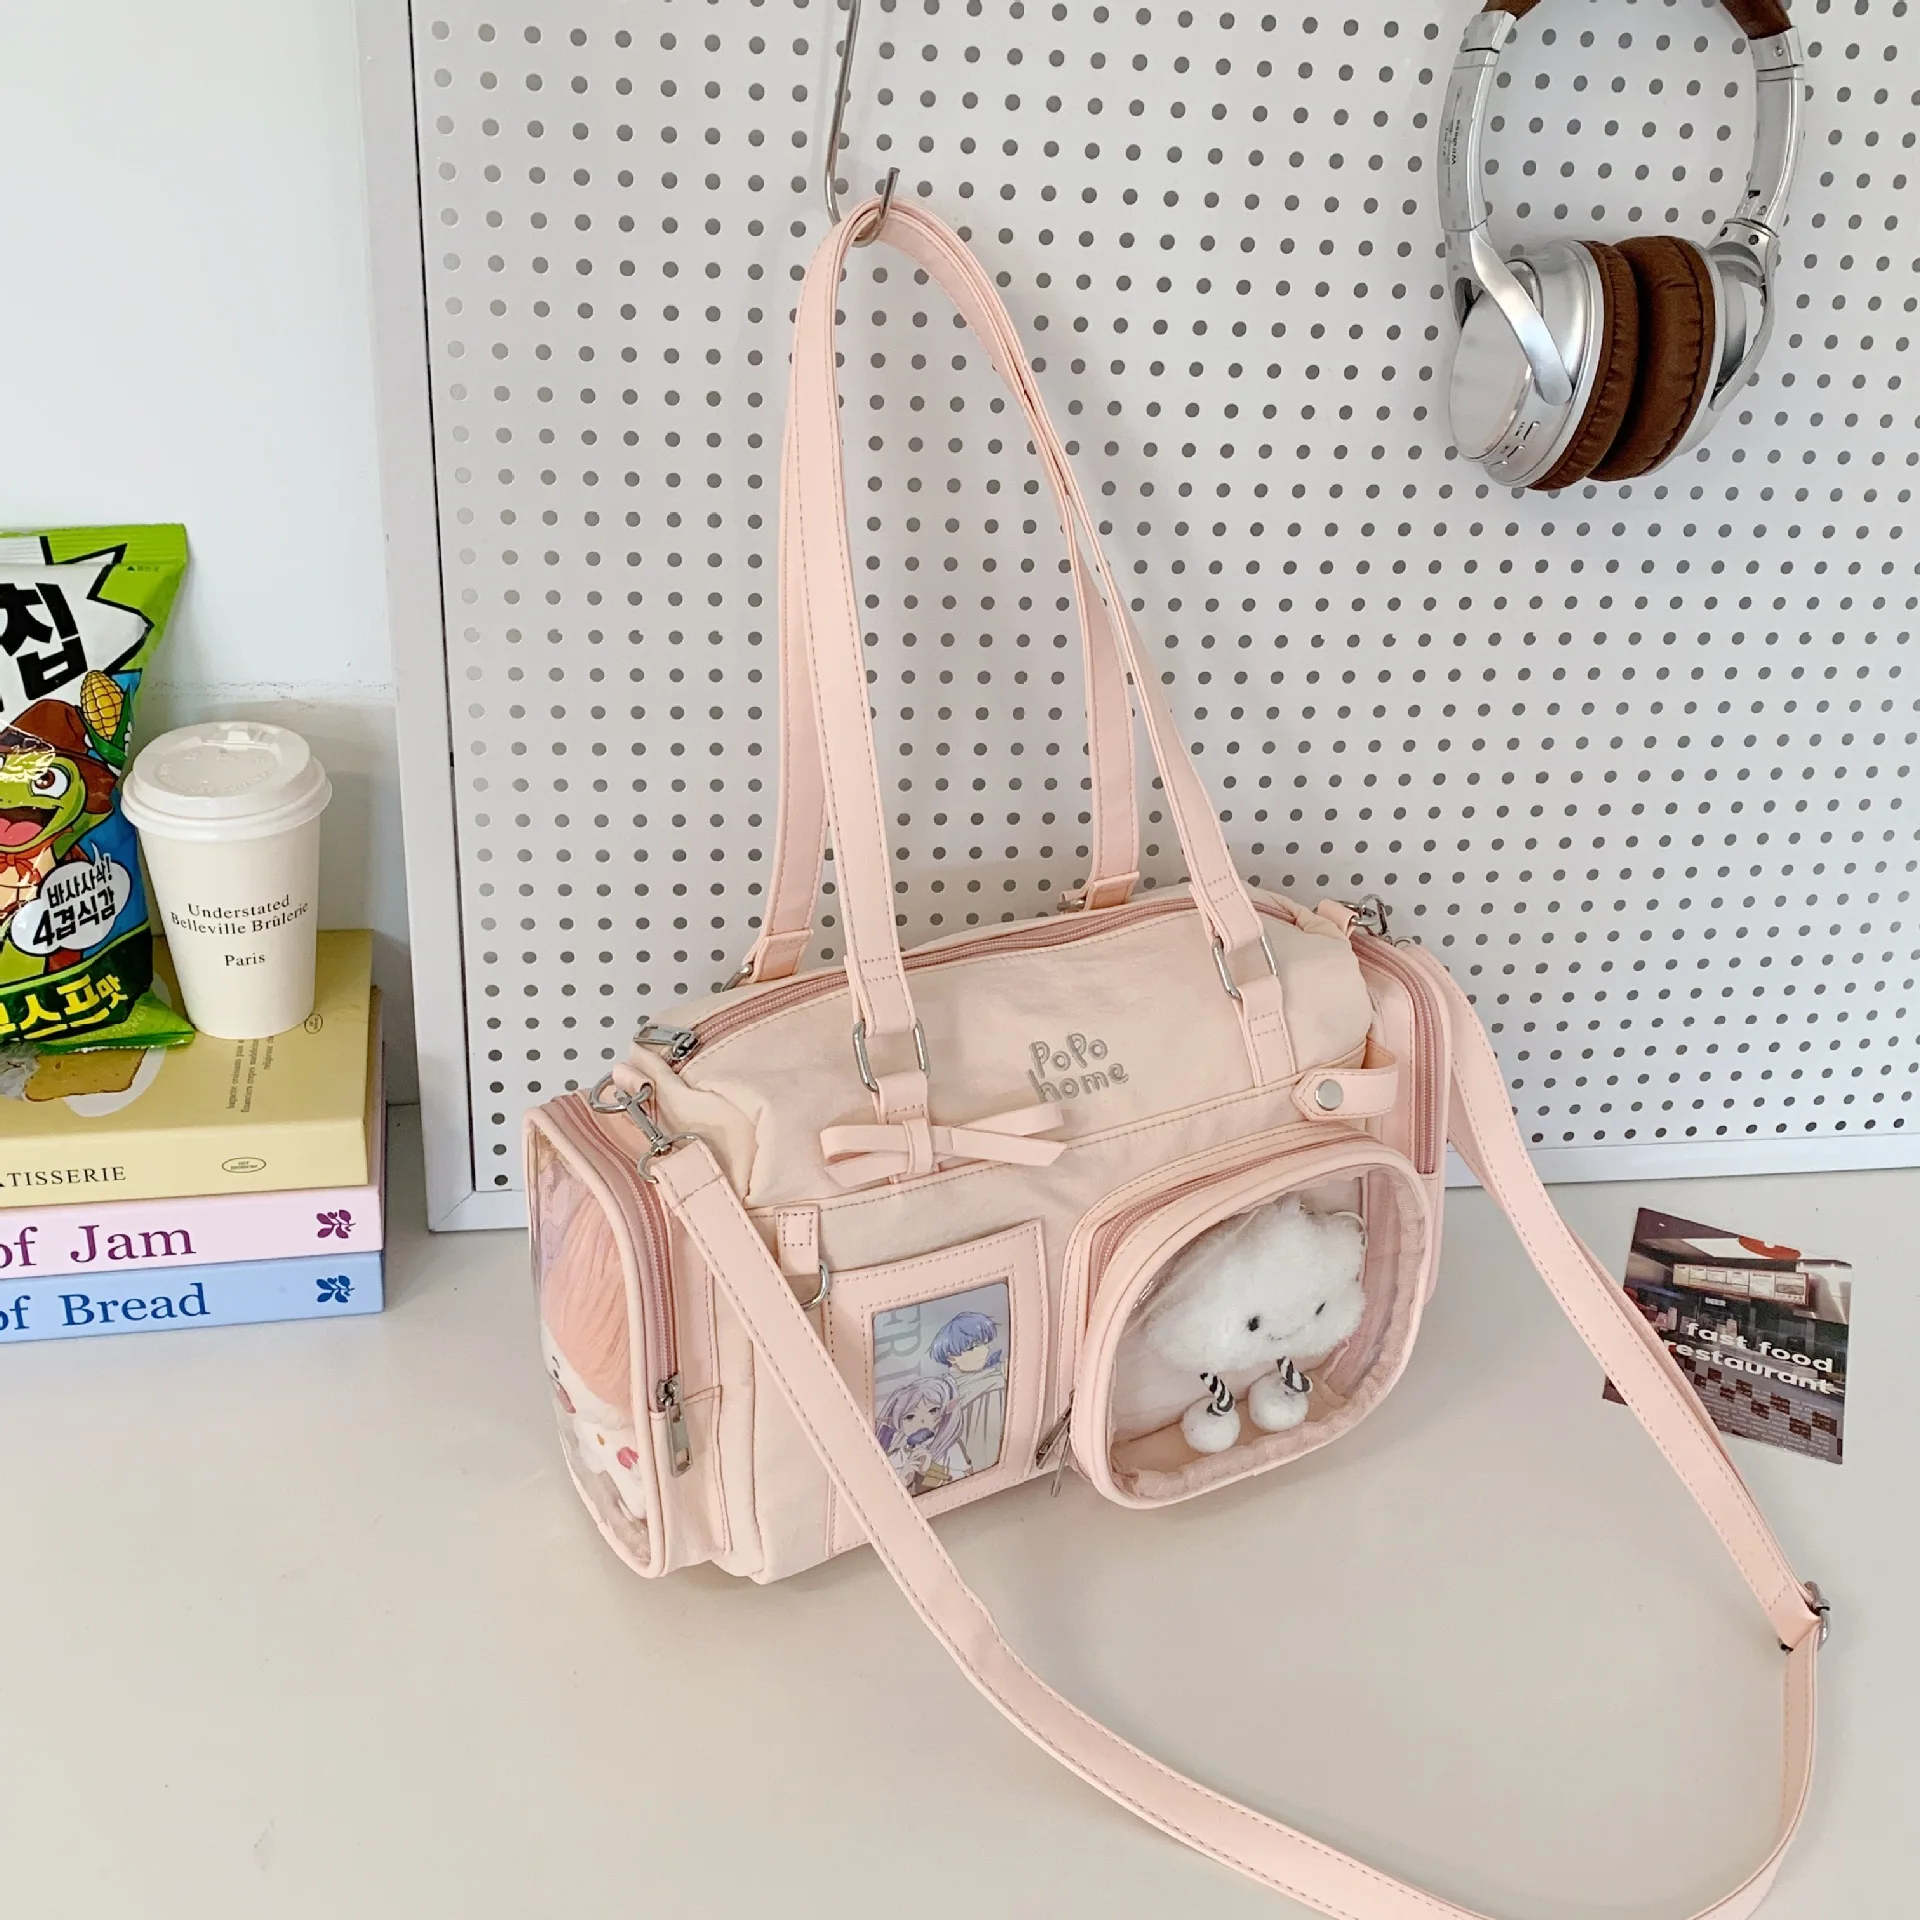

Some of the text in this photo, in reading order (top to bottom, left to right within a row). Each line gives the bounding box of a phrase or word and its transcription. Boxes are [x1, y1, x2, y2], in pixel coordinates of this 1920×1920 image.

[0, 582, 88, 700] 칩
[33, 886, 115, 946] 4겹식감
[170, 902, 309, 935] Belleville Brûlerie
[187, 894, 291, 919] Understated
[224, 952, 266, 967] Paris
[0, 974, 128, 1034] 스프맛
[1028, 1032, 1108, 1079] PoPo
[1026, 1068, 1129, 1104] home
[0, 1166, 126, 1188] TISSERIE
[70, 1224, 197, 1264] Jam
[57, 1282, 211, 1327] Bread
[1664, 1339, 1832, 1395] restaurant
[1686, 1322, 1834, 1373] fast food
